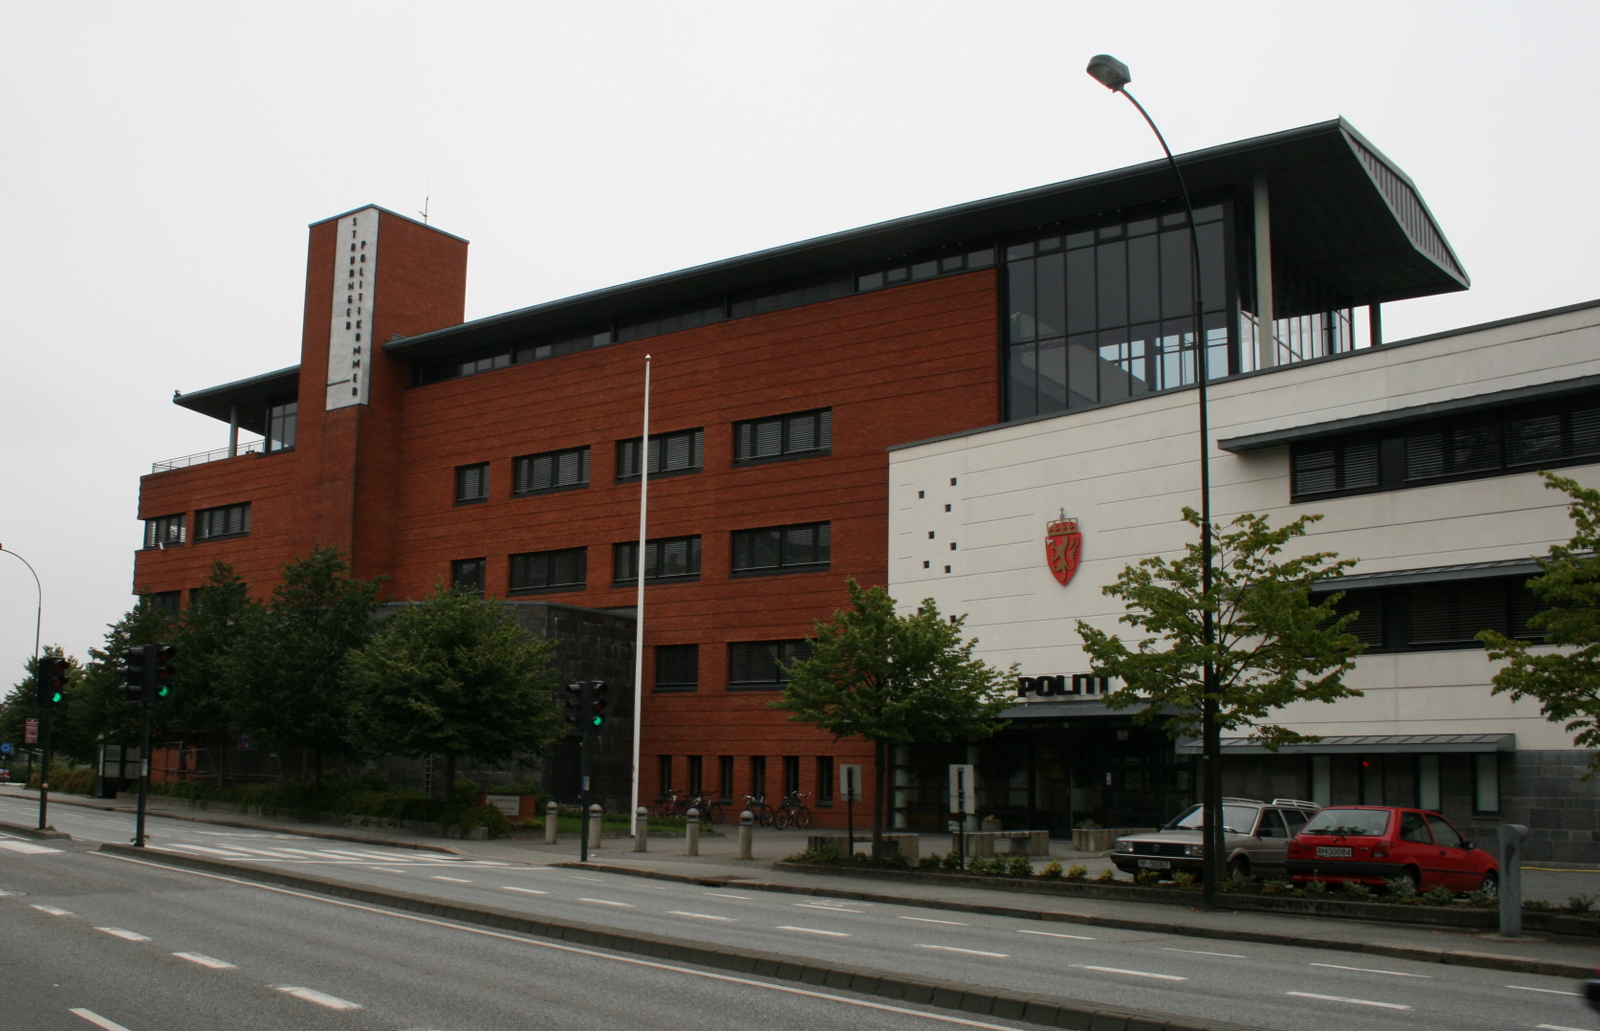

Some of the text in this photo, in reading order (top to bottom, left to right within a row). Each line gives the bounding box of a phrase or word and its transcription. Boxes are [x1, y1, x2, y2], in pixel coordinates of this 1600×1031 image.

[346, 217, 358, 331] STAVANGER
[351, 240, 366, 397] POLITIKAMMER
[1018, 673, 1108, 698] POLITI
